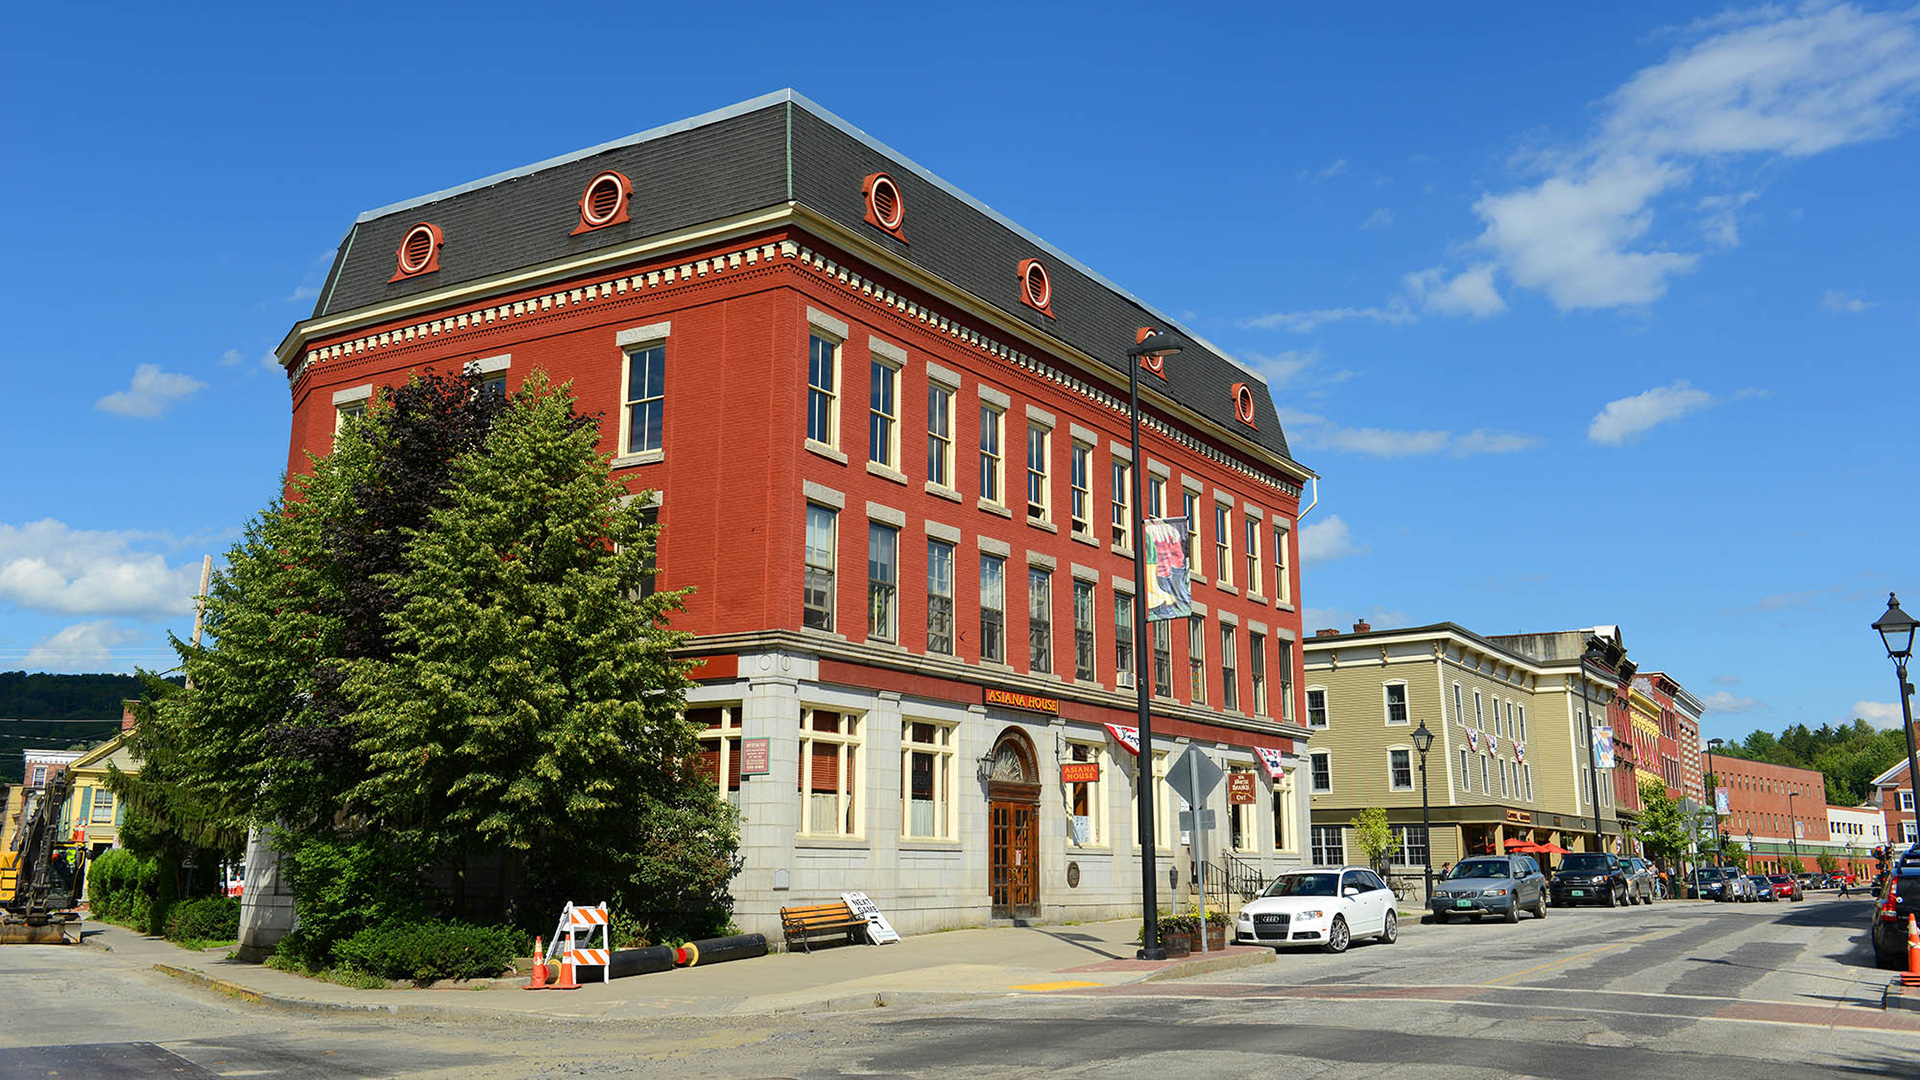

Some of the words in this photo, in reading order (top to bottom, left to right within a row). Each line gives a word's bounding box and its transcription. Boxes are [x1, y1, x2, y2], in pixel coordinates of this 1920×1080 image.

[988, 690, 1025, 707] ASIANA
[1028, 696, 1057, 711] HOUSE
[851, 898, 871, 906] NEXT
[857, 905, 879, 914] GAME
